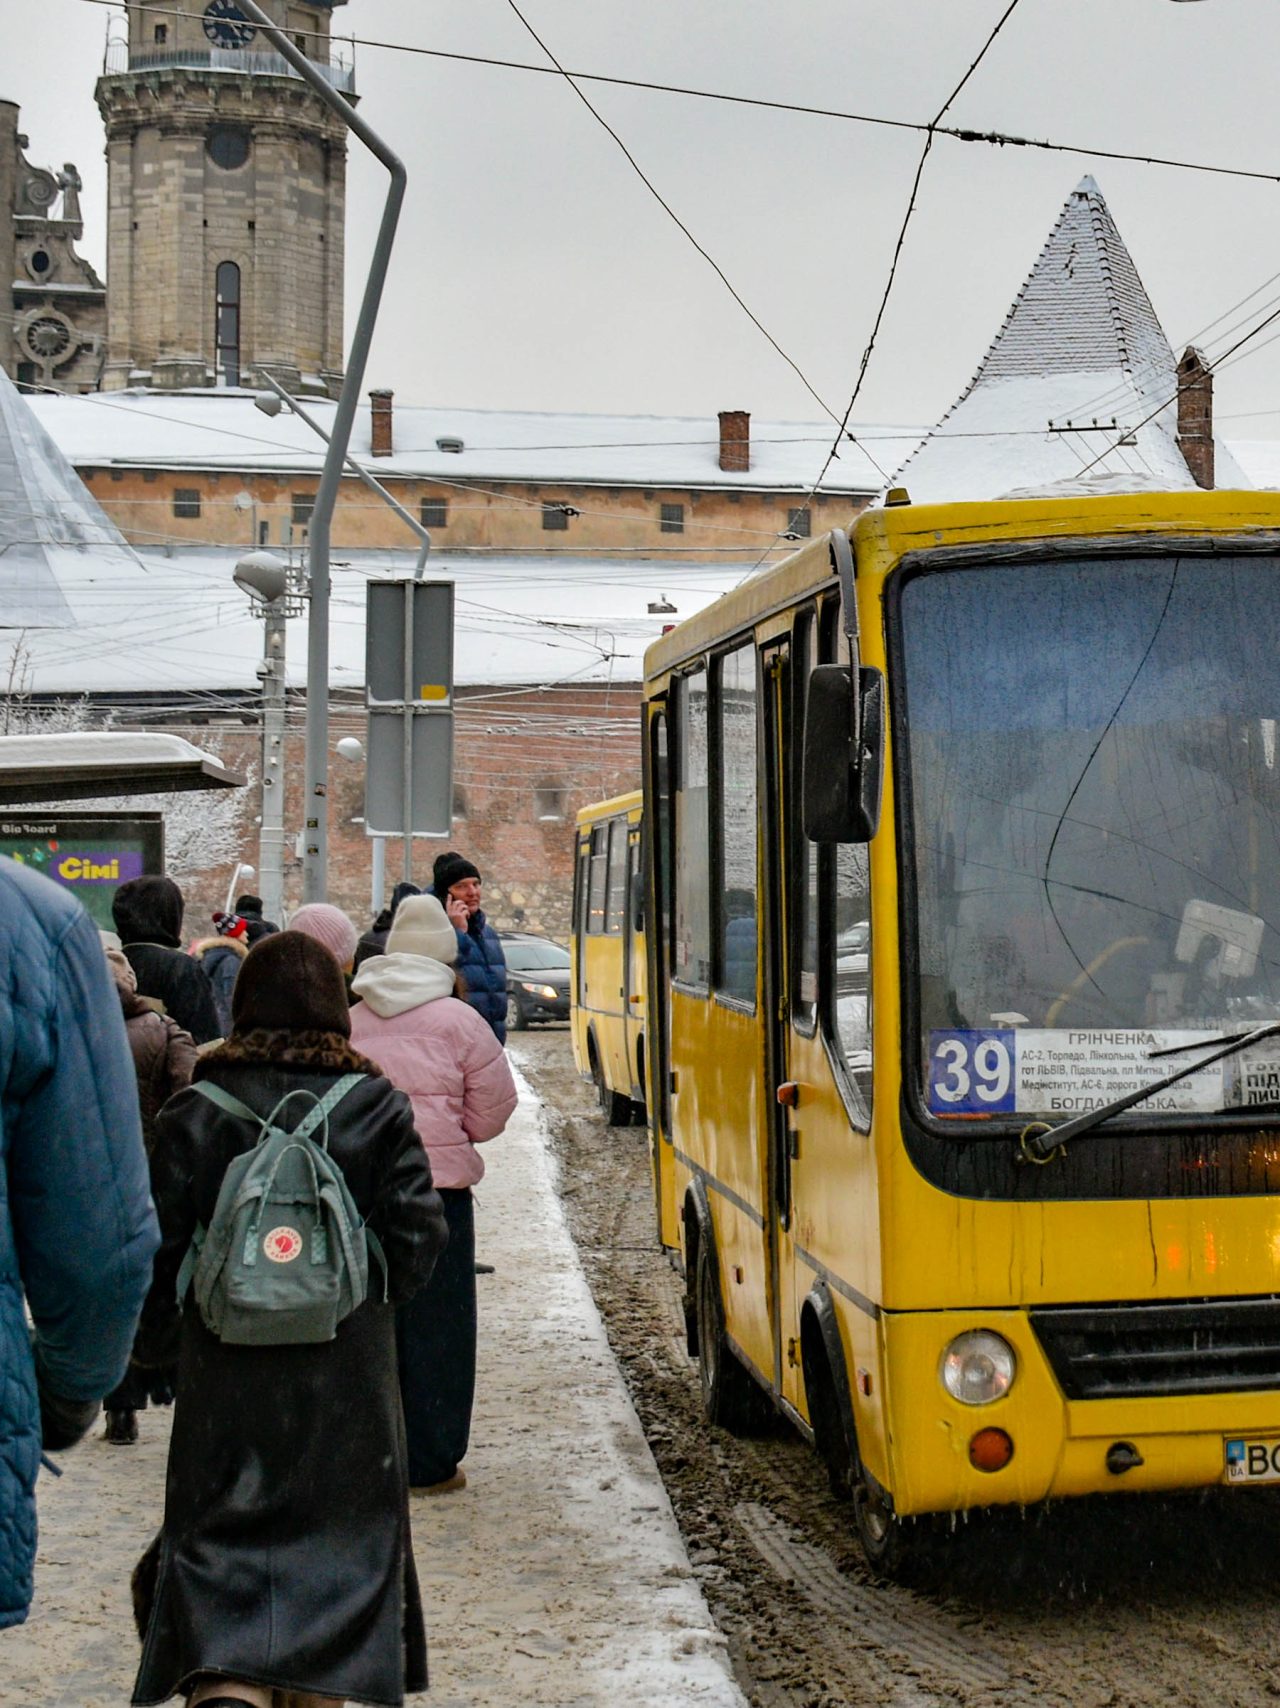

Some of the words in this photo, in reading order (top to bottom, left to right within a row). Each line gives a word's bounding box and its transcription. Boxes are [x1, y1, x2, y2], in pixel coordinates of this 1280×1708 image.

[1068, 1032, 1157, 1045] ГРІНЧЕНКА
[934, 1039, 1011, 1103] 39
[1021, 1066, 1035, 1076] гот
